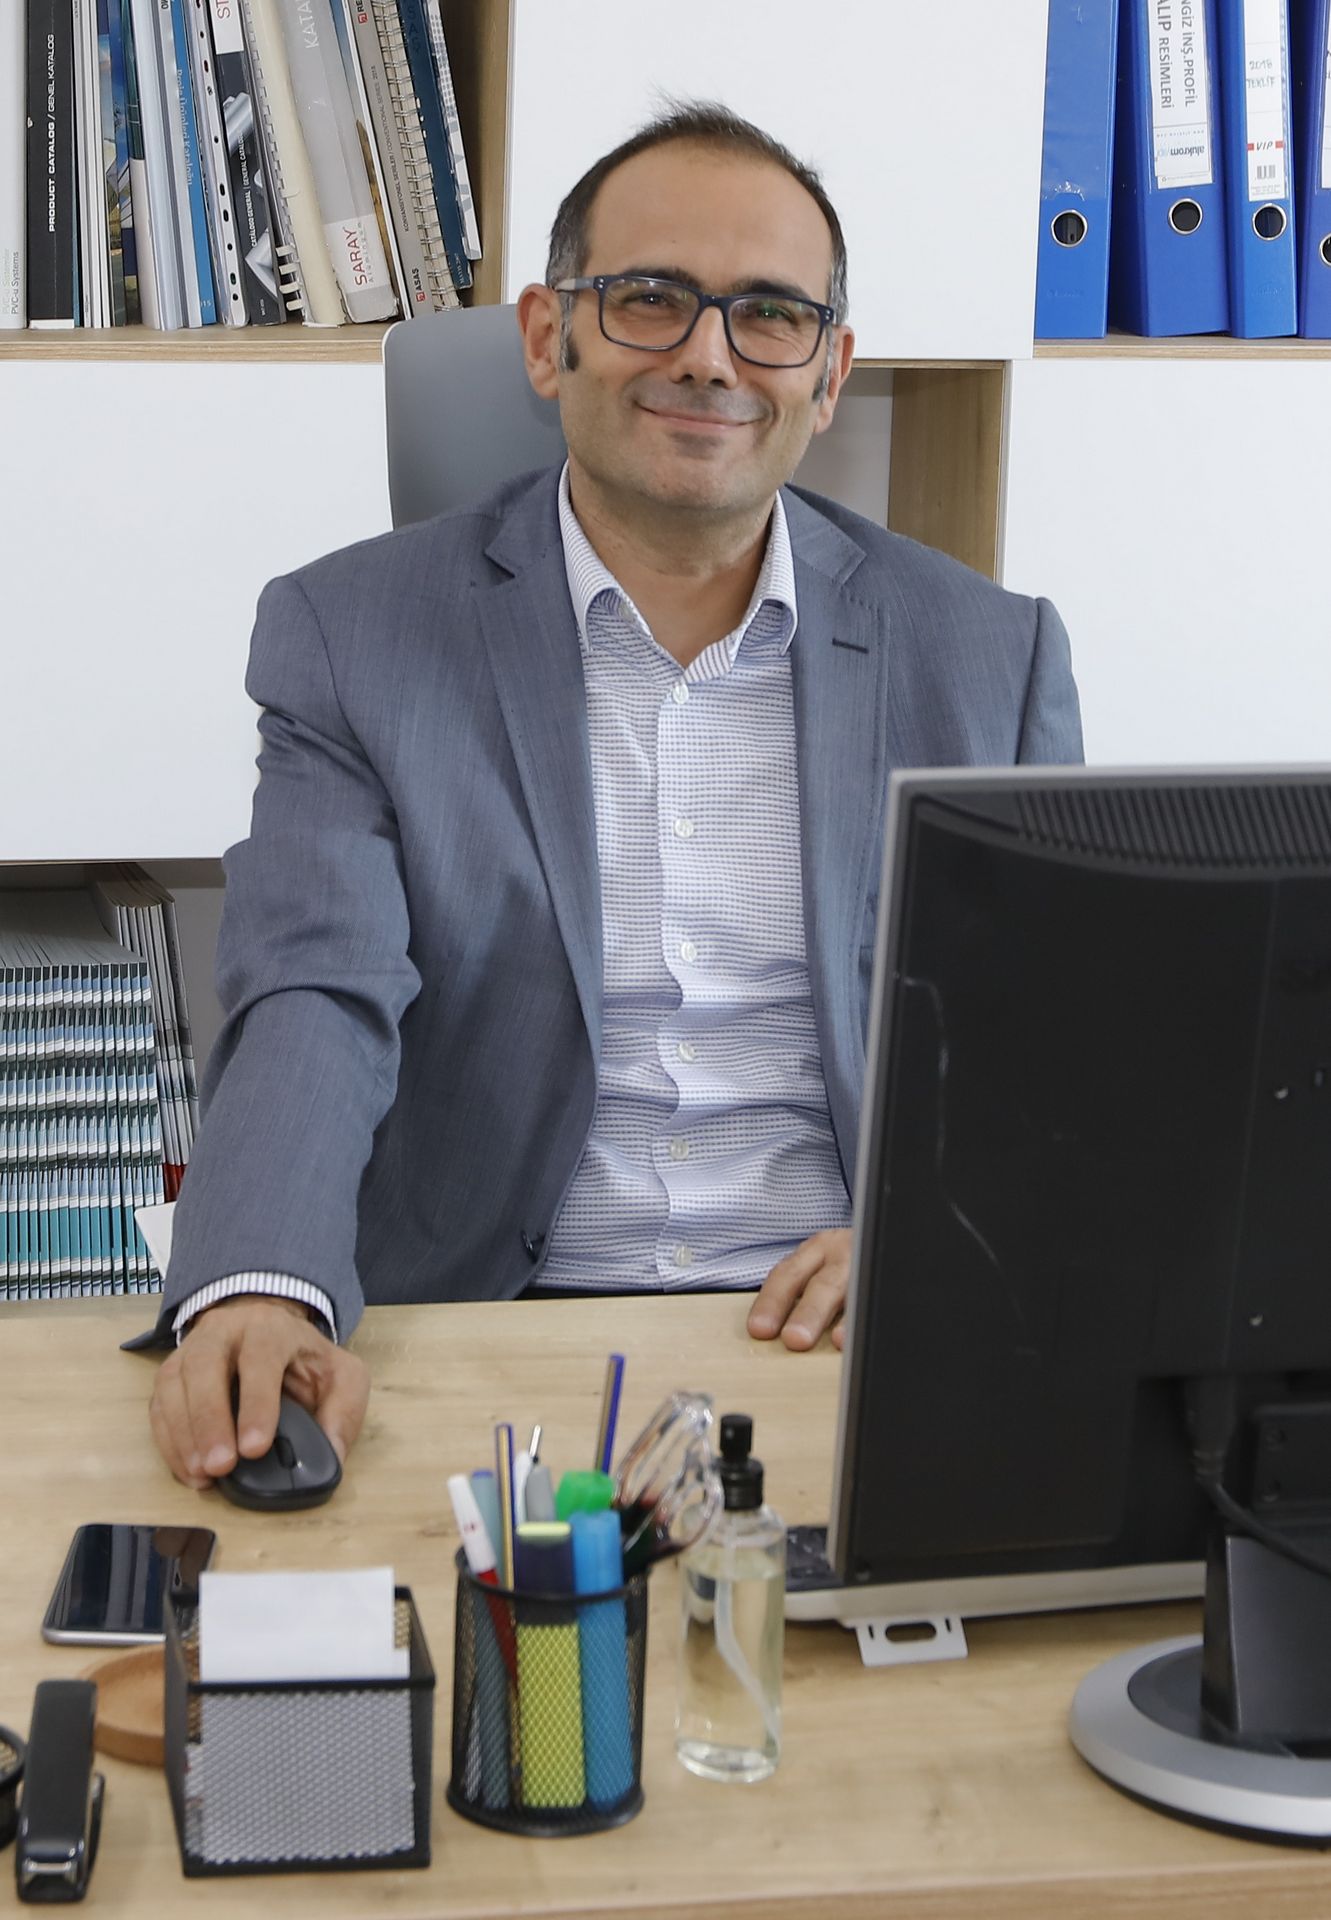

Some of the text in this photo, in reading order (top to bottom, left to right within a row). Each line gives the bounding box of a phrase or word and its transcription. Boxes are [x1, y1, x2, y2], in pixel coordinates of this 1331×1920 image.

[47, 34, 55, 79] KATALOG
[1159, 37, 1174, 108] RESİMLERİ
[47, 80, 55, 112] GENEL
[1256, 141, 1273, 151] VIP
[48, 178, 56, 232] PRODUCT
[10, 251, 20, 315] PVC-u Systems
[344, 228, 368, 286] SARAY
